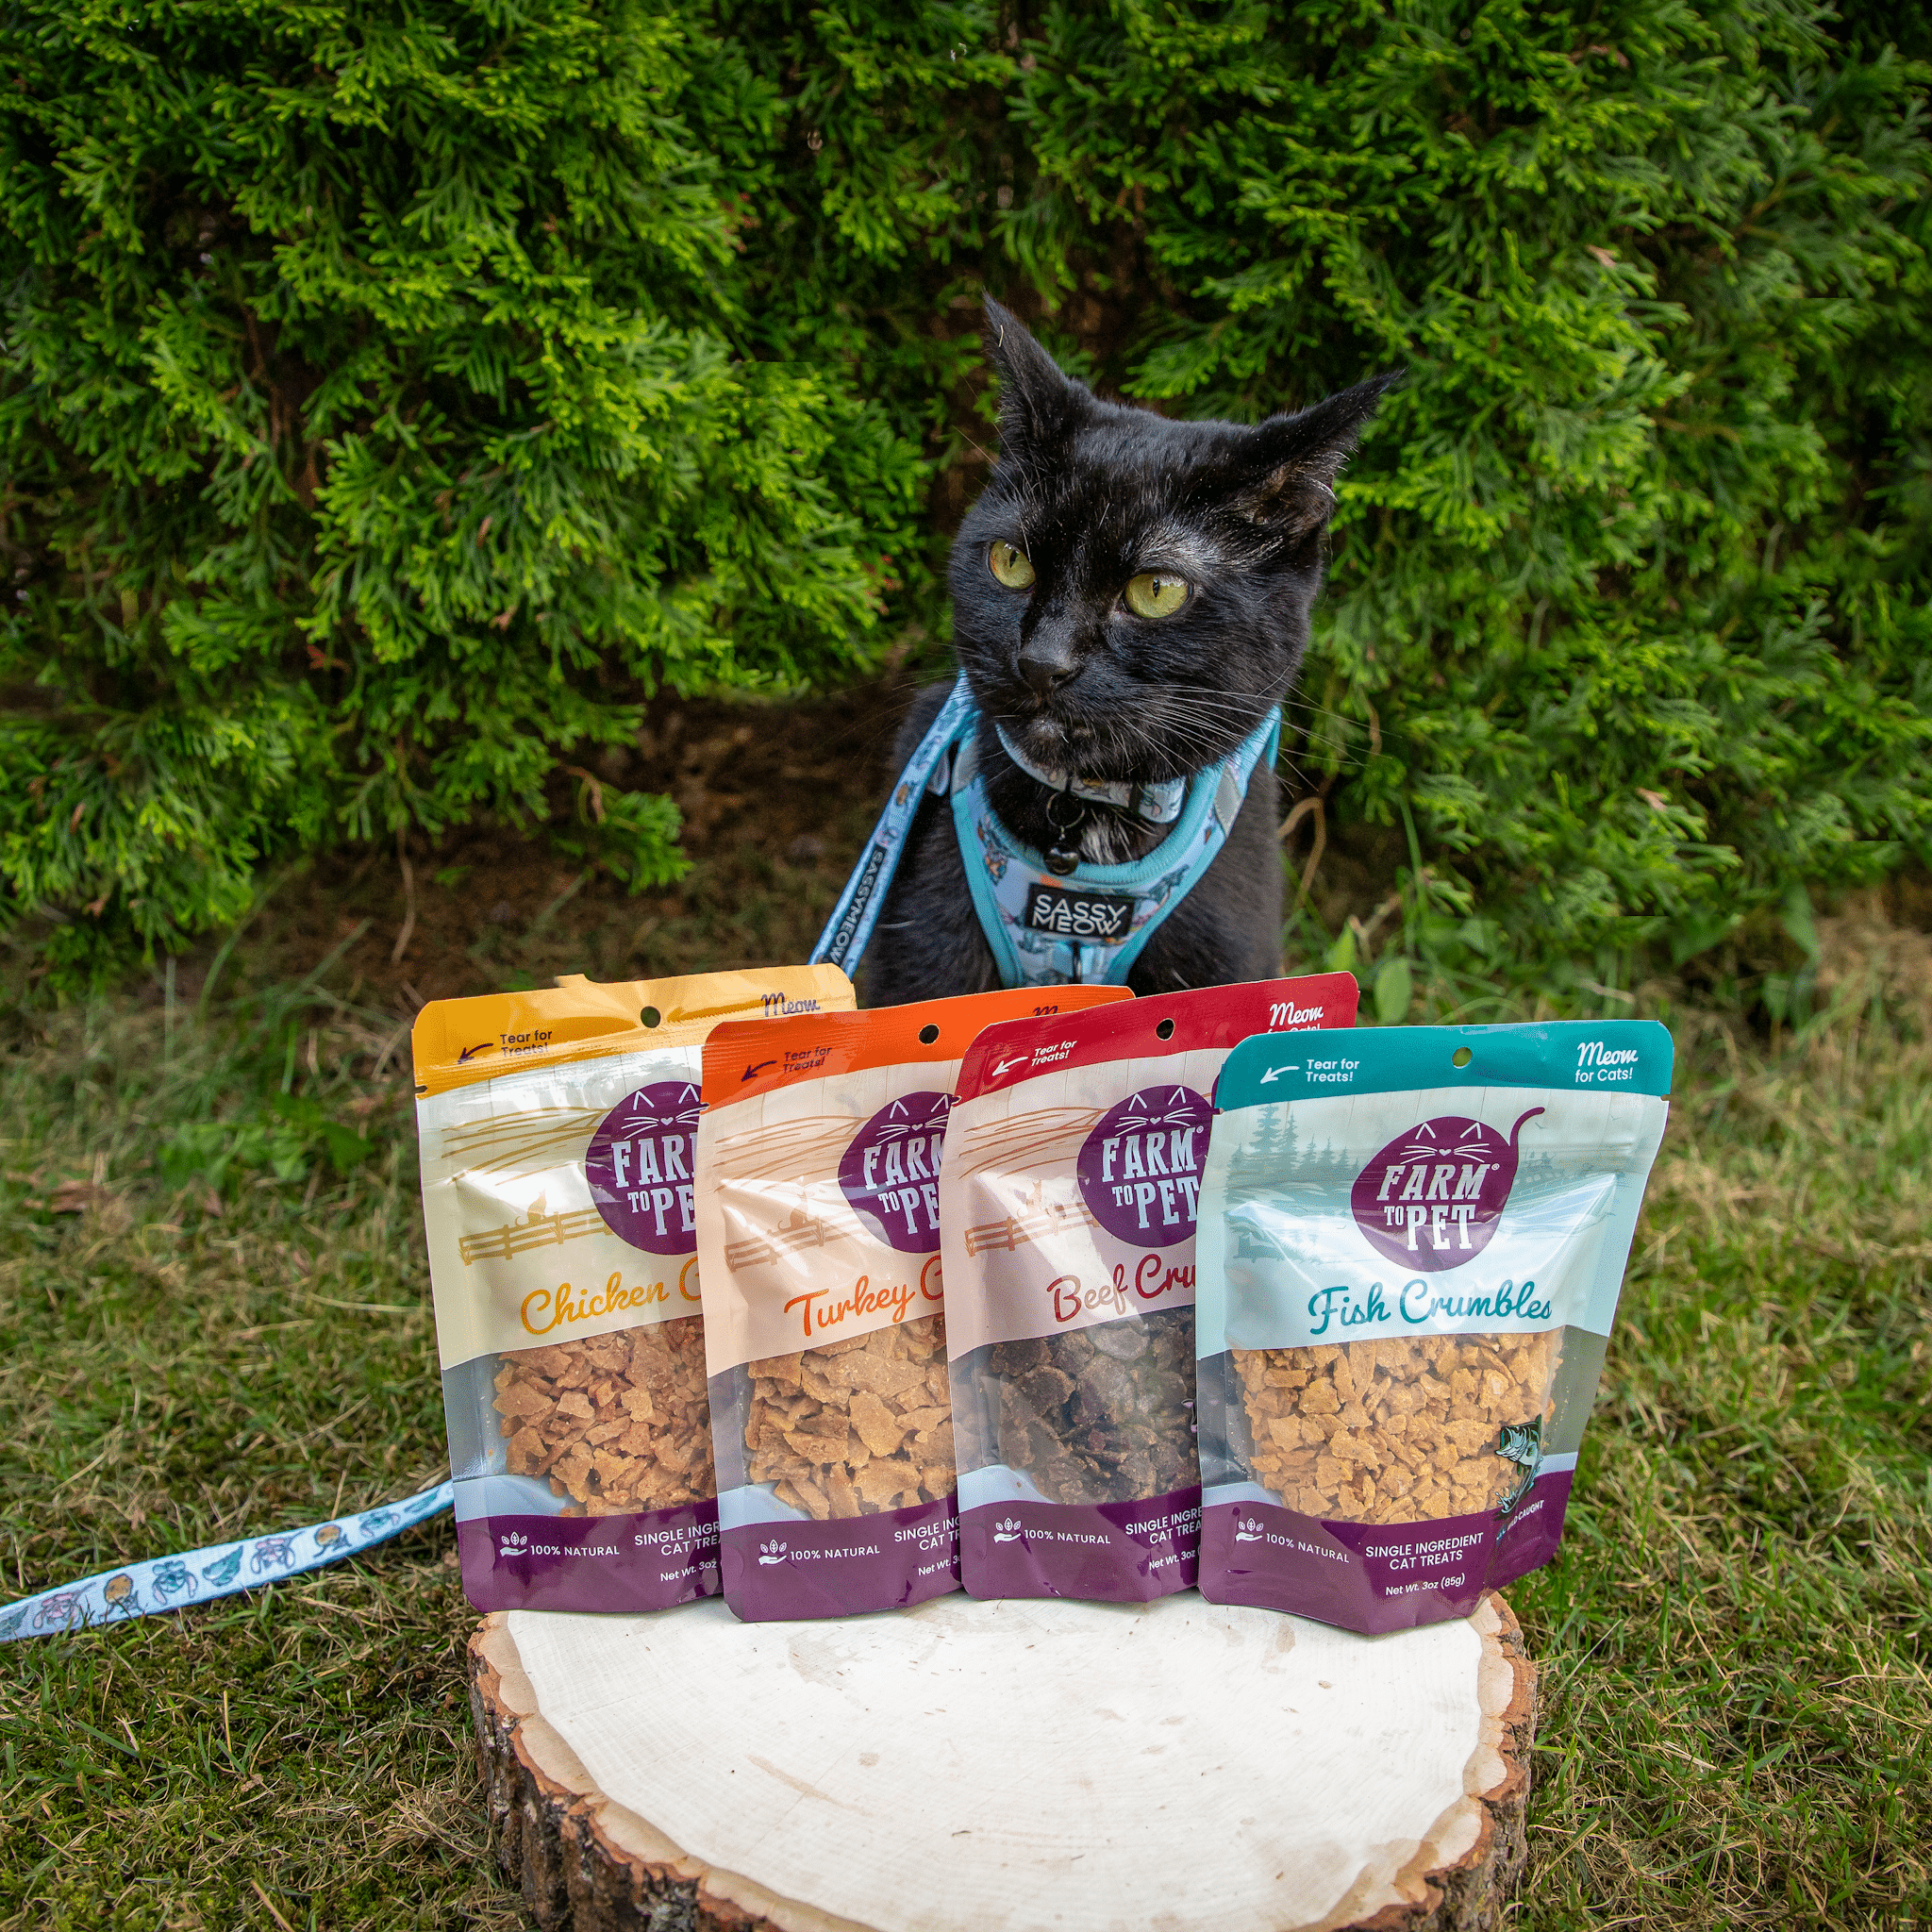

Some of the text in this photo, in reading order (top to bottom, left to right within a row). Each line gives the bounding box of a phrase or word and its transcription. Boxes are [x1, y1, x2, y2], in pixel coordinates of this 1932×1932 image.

[1034, 893, 1127, 923] SASSY
[1032, 910, 1122, 935] MEOW
[761, 991, 821, 1017] Meow
[1269, 1001, 1324, 1026] Meow
[500, 1029, 553, 1044] Tear for
[500, 1042, 548, 1057] Treats!
[784, 1046, 832, 1062] Tear for
[1031, 1049, 1070, 1067] Treats!
[1034, 1040, 1077, 1057] Tear for
[1576, 1041, 1639, 1067] Meow
[783, 1056, 826, 1073] Treats!
[1307, 1058, 1360, 1070] Tear for
[1574, 1066, 1634, 1083] for Cats!
[1305, 1071, 1354, 1082] Treats!
[610, 1131, 698, 1189] FAR
[626, 1190, 651, 1214] TO
[877, 1182, 941, 1235] TO PE
[1111, 1175, 1200, 1229] TO PET
[1383, 1204, 1476, 1251] TO PET
[521, 1271, 670, 1336] Chicken
[1046, 1263, 1128, 1323] Beef
[783, 1274, 916, 1337] Turkey
[1307, 1278, 1553, 1335] Fish Crumbles
[1518, 1499, 1544, 1521] CAUGHT
[894, 1522, 940, 1542] SINGLE
[1125, 1515, 1168, 1535] SINGLE
[1149, 1520, 1202, 1544] CAT TREA
[634, 1528, 684, 1546] SINGLE
[660, 1534, 721, 1557] CAT TRE
[919, 1534, 944, 1551] CAT
[1024, 1529, 1111, 1544] 100% NATURAL
[1365, 1532, 1484, 1557] SINGLE INGREDIENT
[530, 1544, 620, 1557] 100% NATURAL
[791, 1544, 881, 1561] 100% NATURAL
[1266, 1532, 1350, 1564] 100% NATURAL
[660, 1559, 717, 1582] Net Wt. 3oz
[918, 1563, 936, 1576] Net
[936, 1558, 951, 1570] Wt.
[1149, 1558, 1164, 1571] Net
[1165, 1554, 1180, 1566] Wt.
[1180, 1549, 1196, 1561] 3oz
[1389, 1549, 1464, 1571] CAT TREATS
[1385, 1572, 1466, 1596] Net Wt. 3oz (85g)
